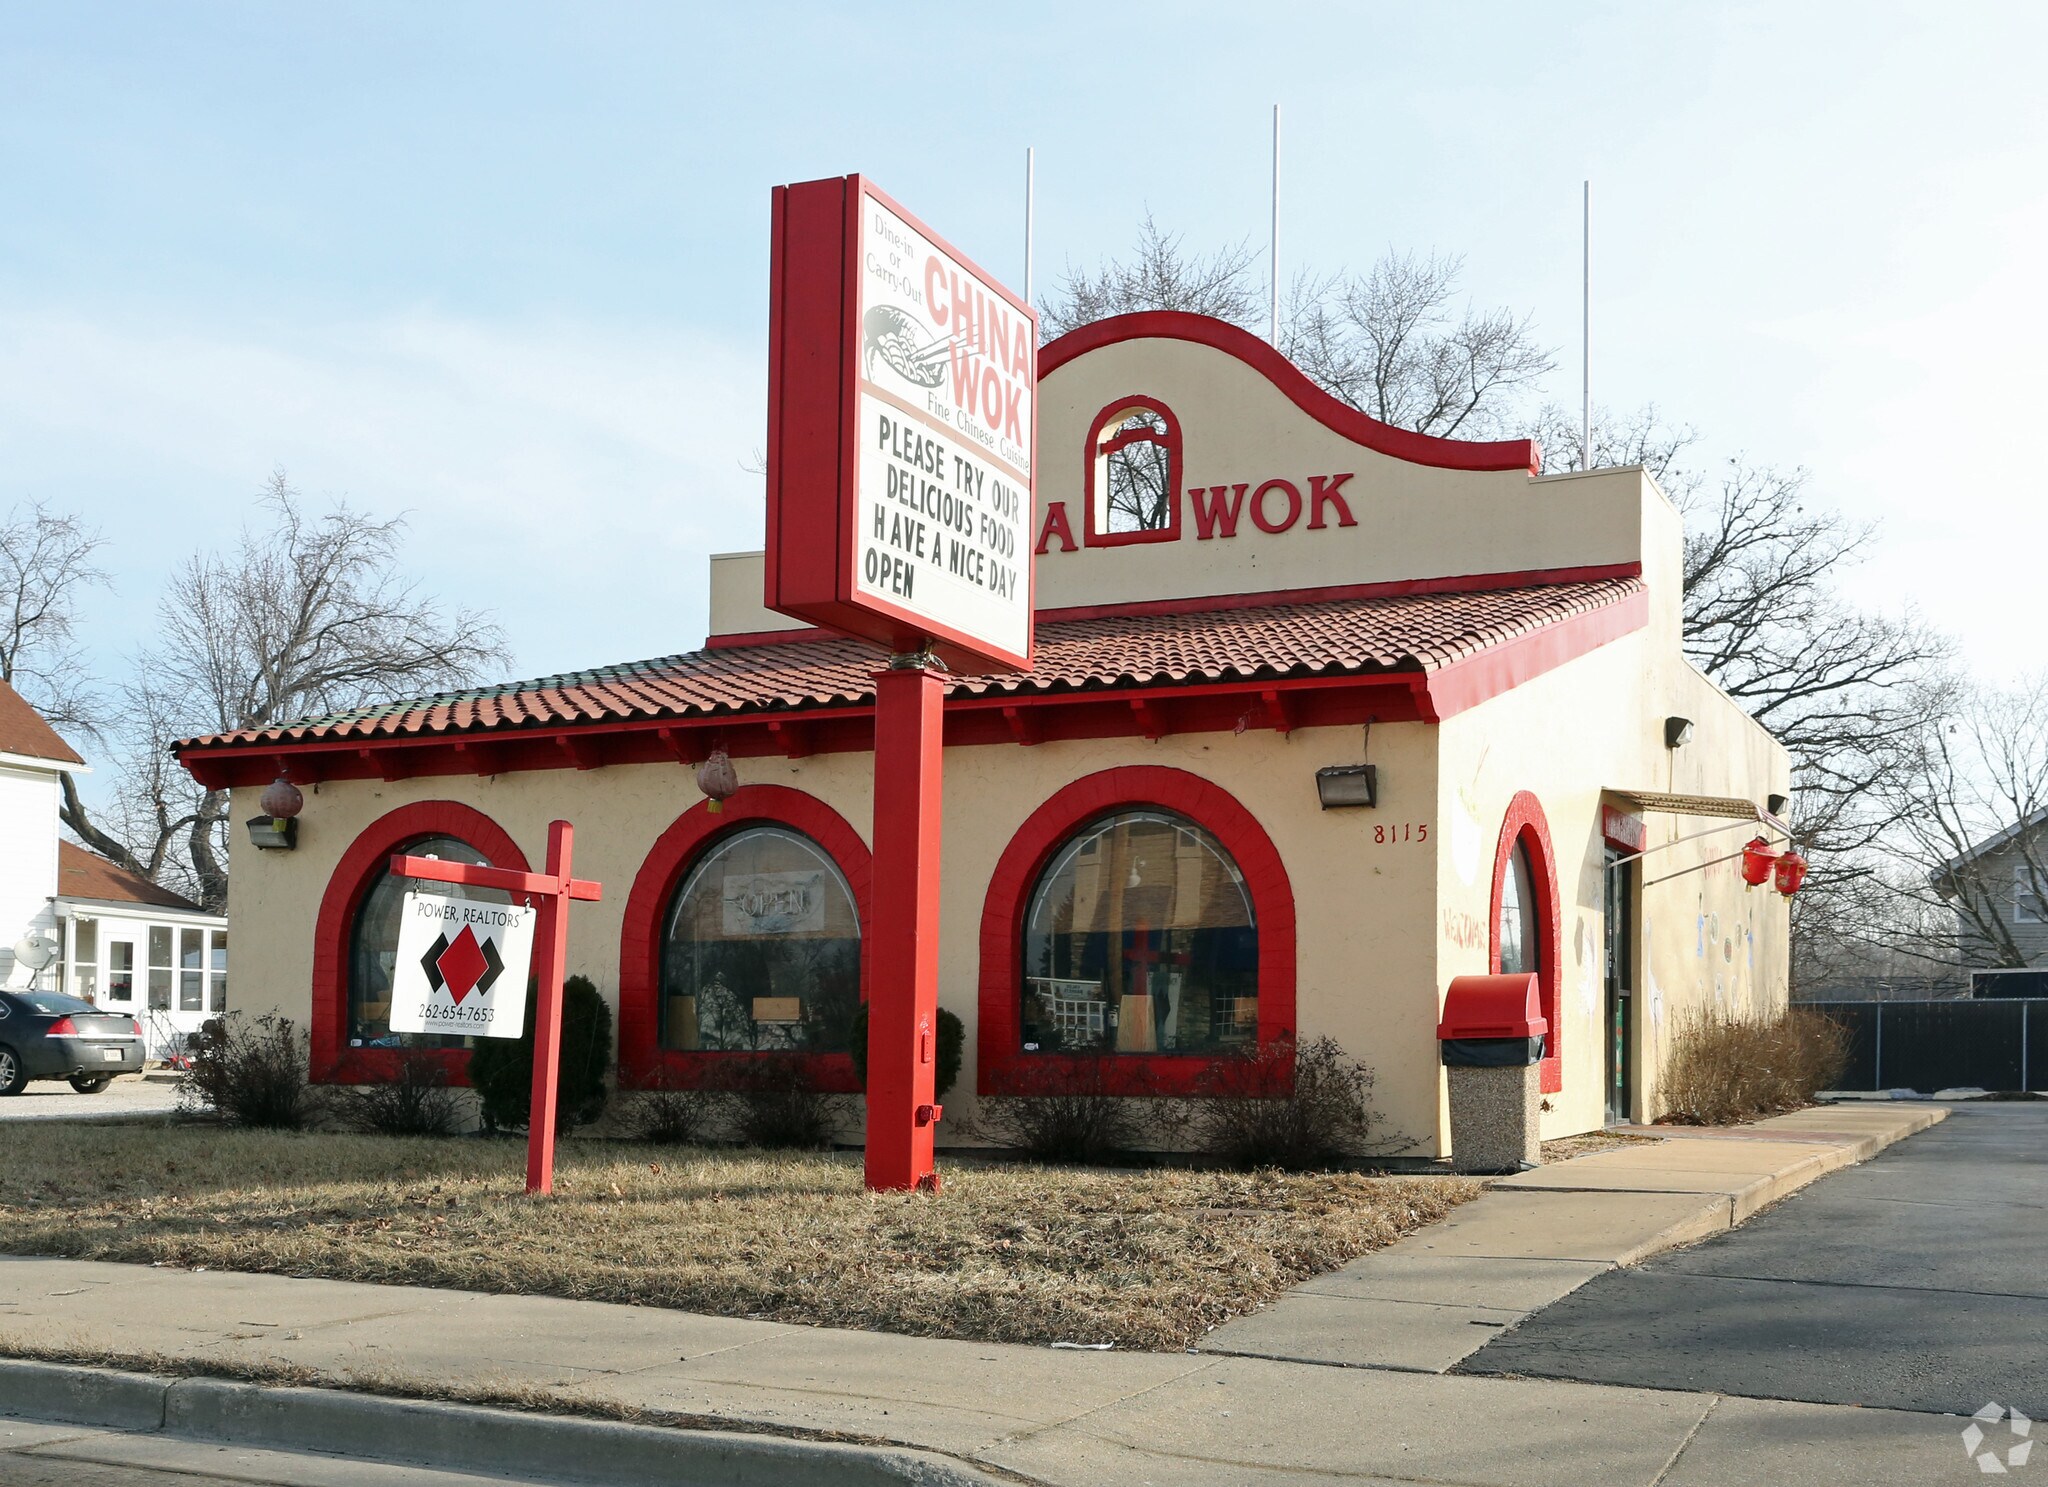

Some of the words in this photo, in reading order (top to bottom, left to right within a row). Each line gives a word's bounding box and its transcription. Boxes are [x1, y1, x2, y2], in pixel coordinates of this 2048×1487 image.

[875, 214, 914, 259] Dine-in
[889, 249, 901, 269] or
[866, 252, 922, 305] Carry-Out
[925, 255, 1031, 389] CHINA
[949, 339, 1023, 448] WOK
[928, 391, 950, 422] Fine
[956, 409, 994, 449] Chinese
[1000, 438, 1029, 473] Cuisine
[879, 414, 945, 480] PLEASE
[954, 455, 984, 501] TRY
[992, 479, 1019, 525] OUR
[887, 463, 973, 538] DELICIOUS
[980, 512, 1014, 560] FOOD
[1188, 473, 1358, 540] WOK
[865, 547, 915, 600] OPEN
[874, 503, 925, 559] HAVE
[931, 531, 942, 567] A
[950, 538, 983, 586] NICE
[989, 561, 1017, 601] DAY
[1373, 823, 1427, 844] 8115
[418, 902, 459, 924] POWER,
[463, 908, 519, 928] REALTORS
[743, 889, 804, 916] OPEN
[418, 1004, 495, 1022] 262-654-7653
